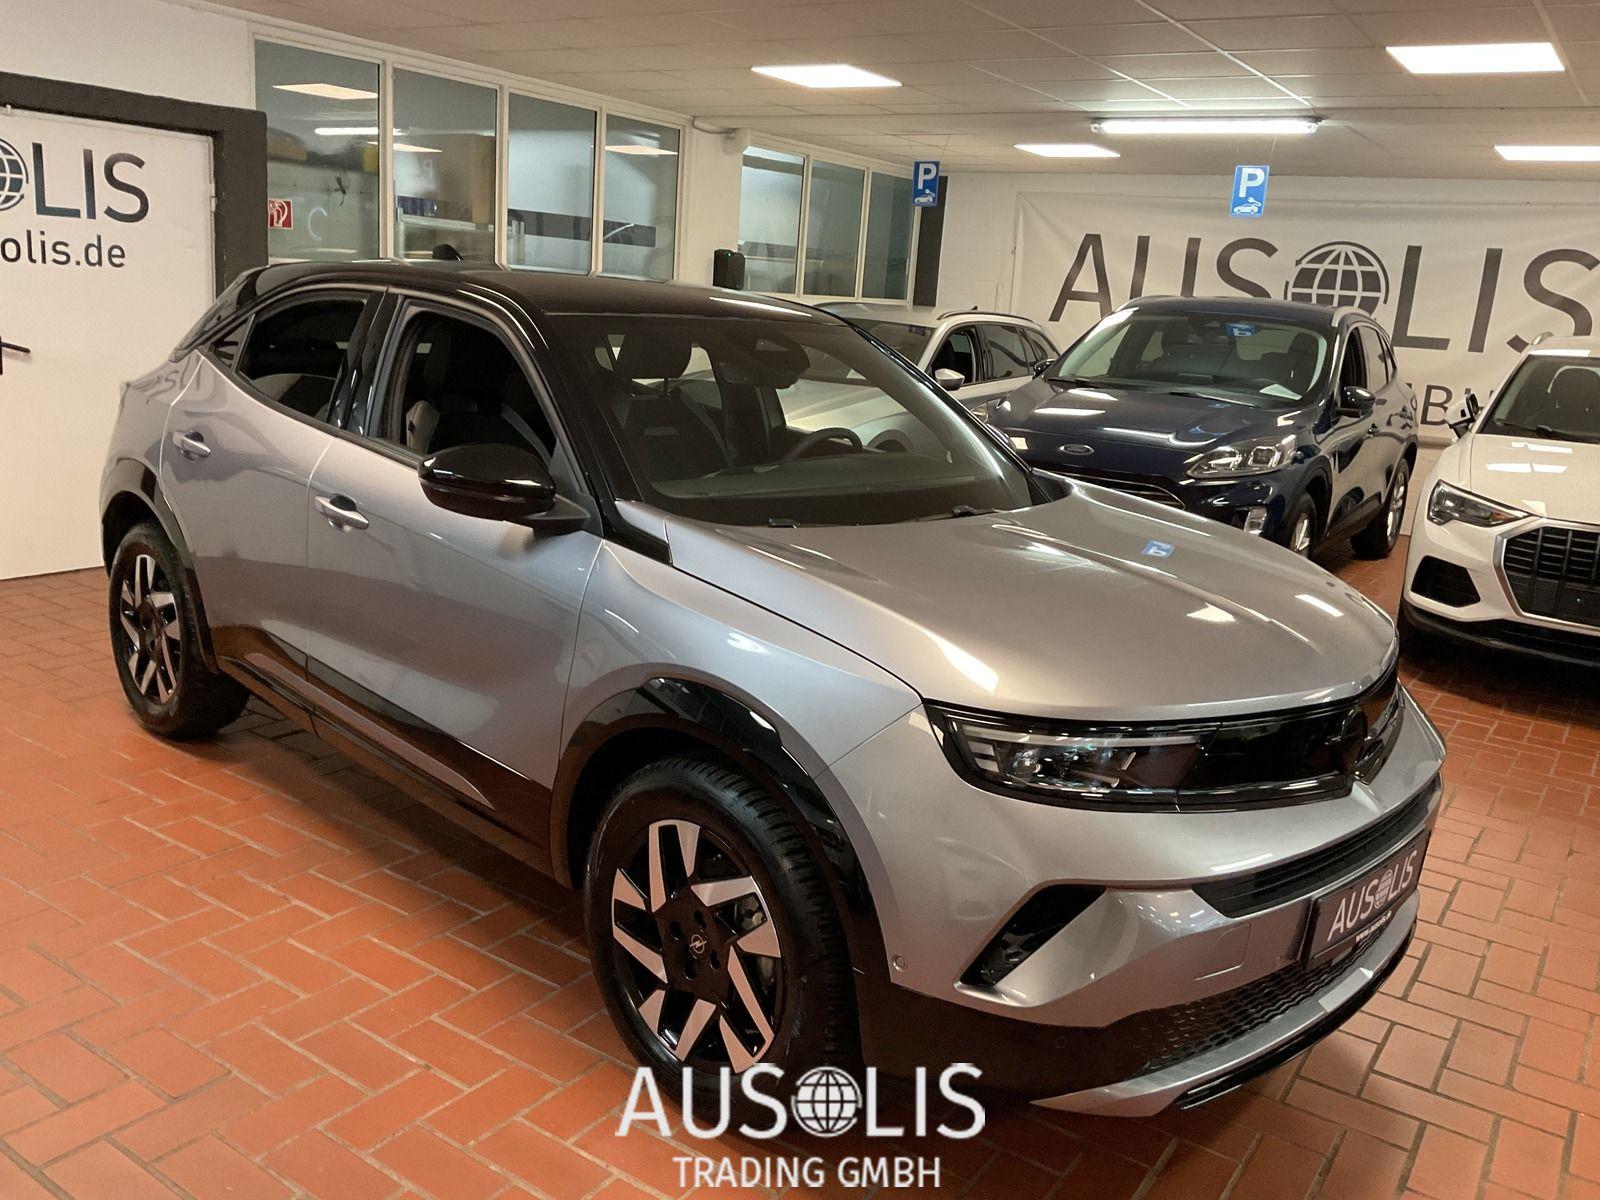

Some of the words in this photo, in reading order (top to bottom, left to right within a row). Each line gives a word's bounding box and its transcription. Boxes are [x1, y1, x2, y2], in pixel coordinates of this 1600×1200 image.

[917, 163, 937, 190] P
[1239, 167, 1265, 198] P
[0, 229, 126, 268] olis.de
